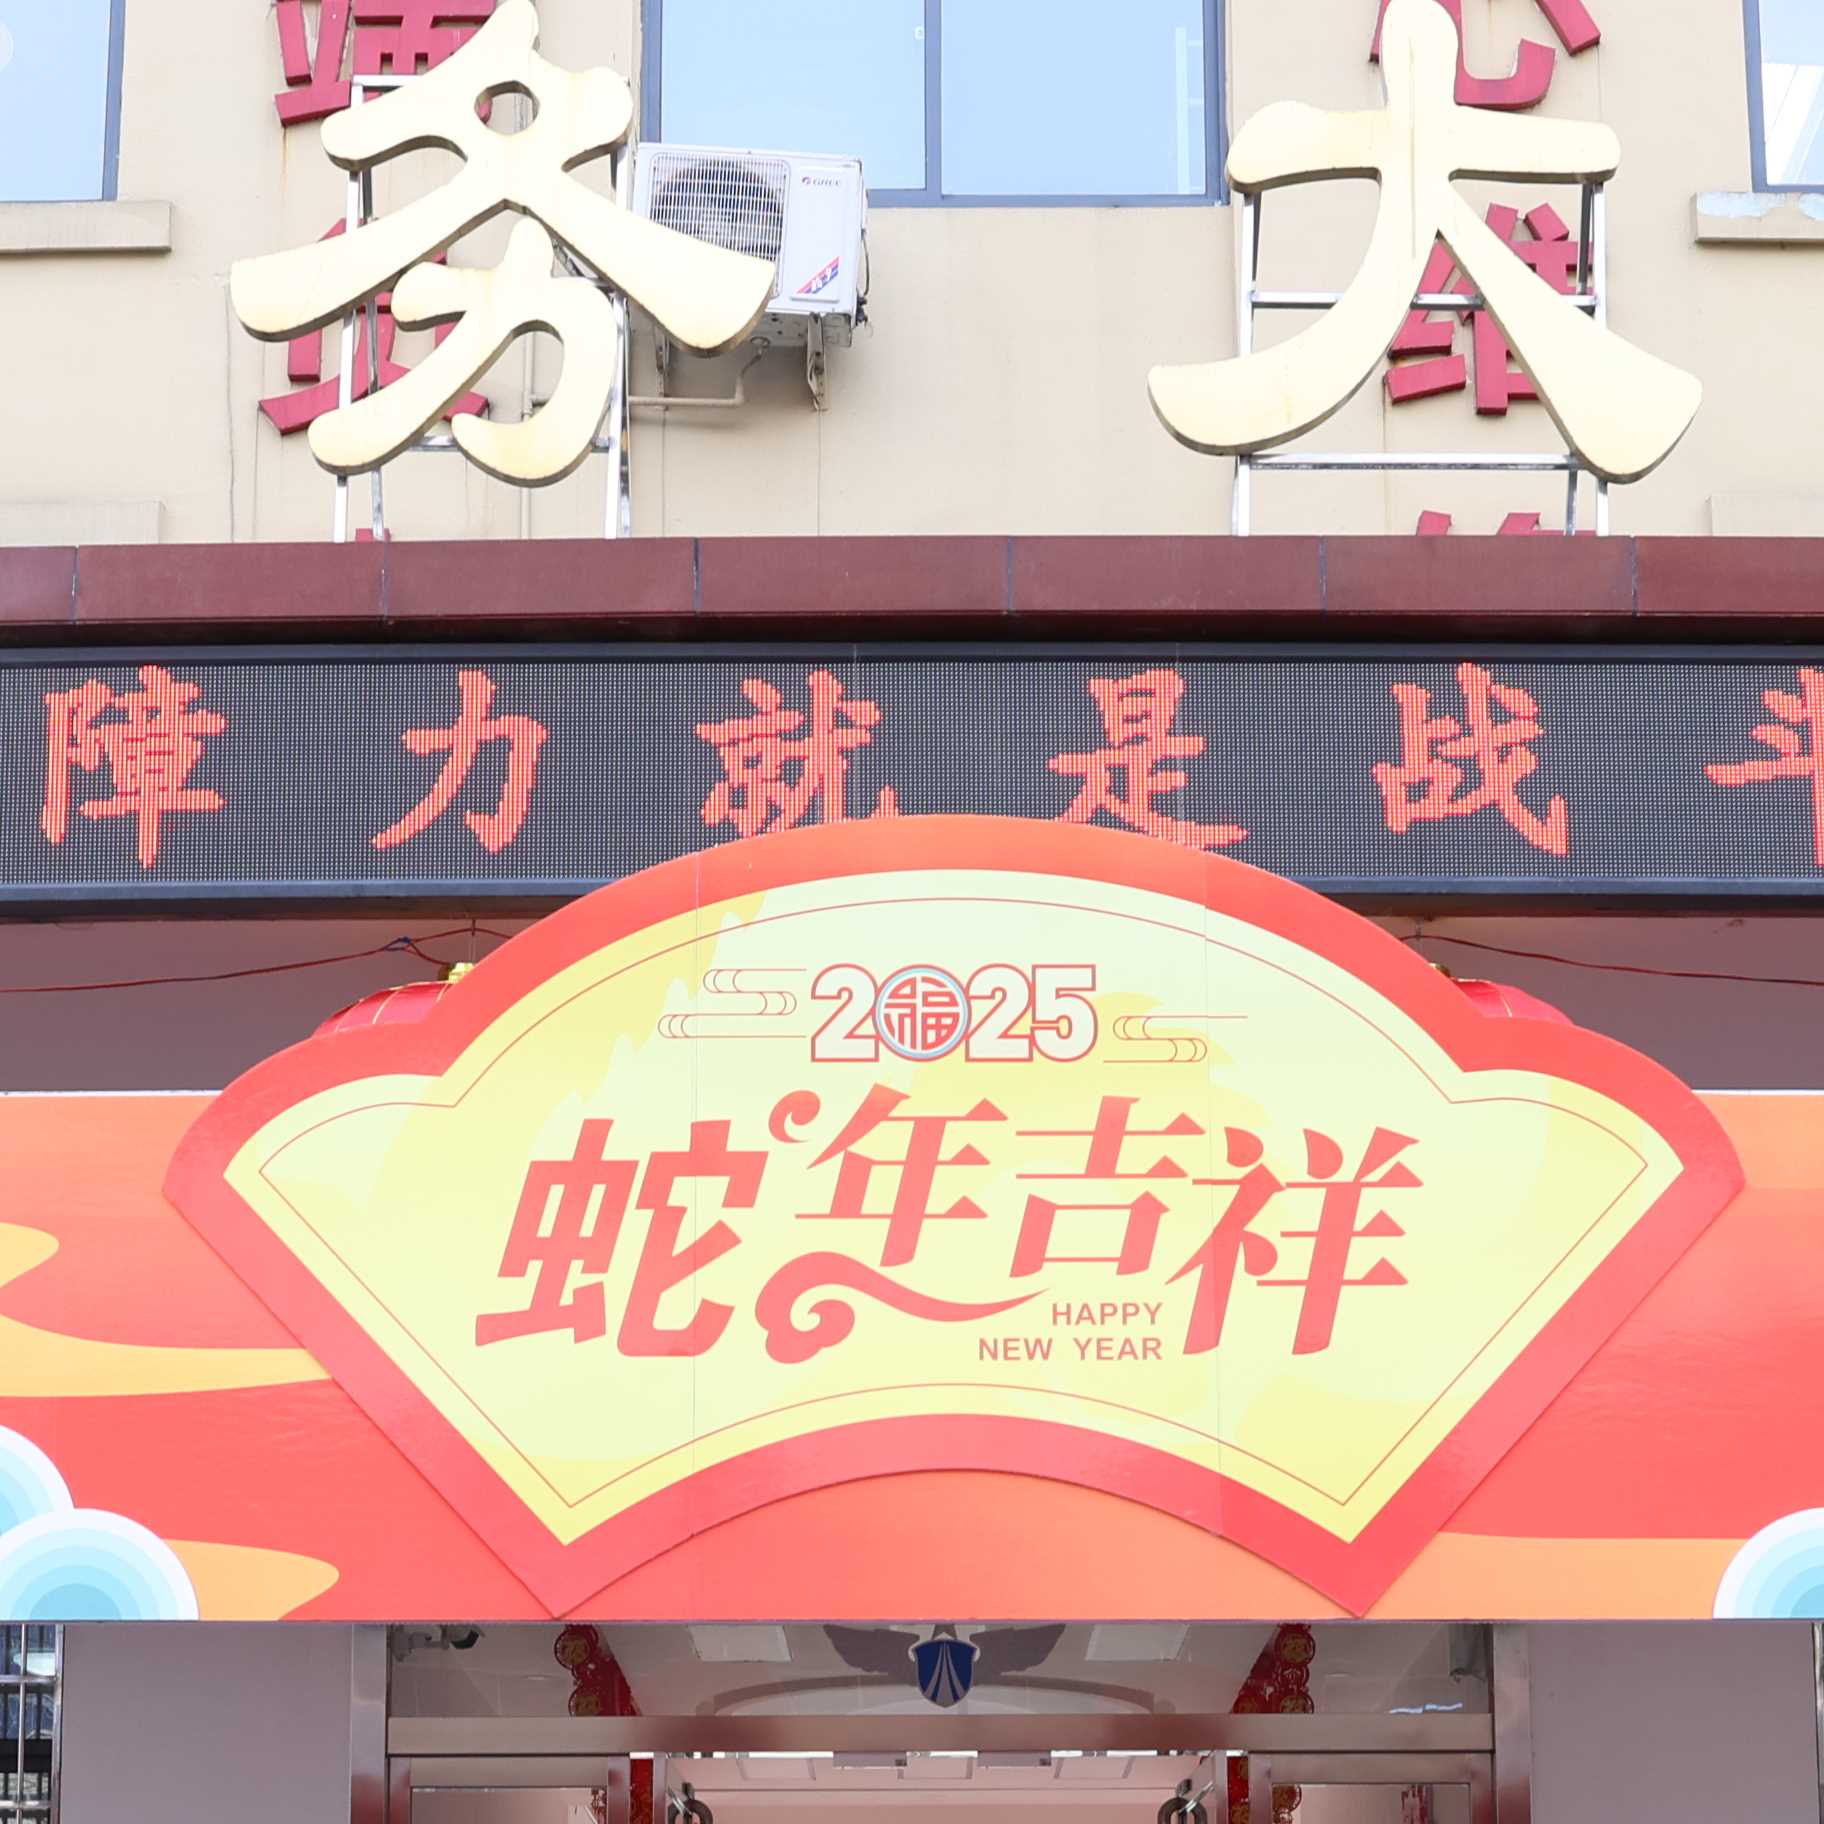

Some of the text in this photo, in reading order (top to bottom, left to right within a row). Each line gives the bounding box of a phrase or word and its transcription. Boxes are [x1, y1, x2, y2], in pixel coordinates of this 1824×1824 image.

[475, 1083, 1424, 1364] 蛇年吉祥
[1051, 1302, 1162, 1327] HAPPY
[978, 1336, 1163, 1362] NEW YEAR
